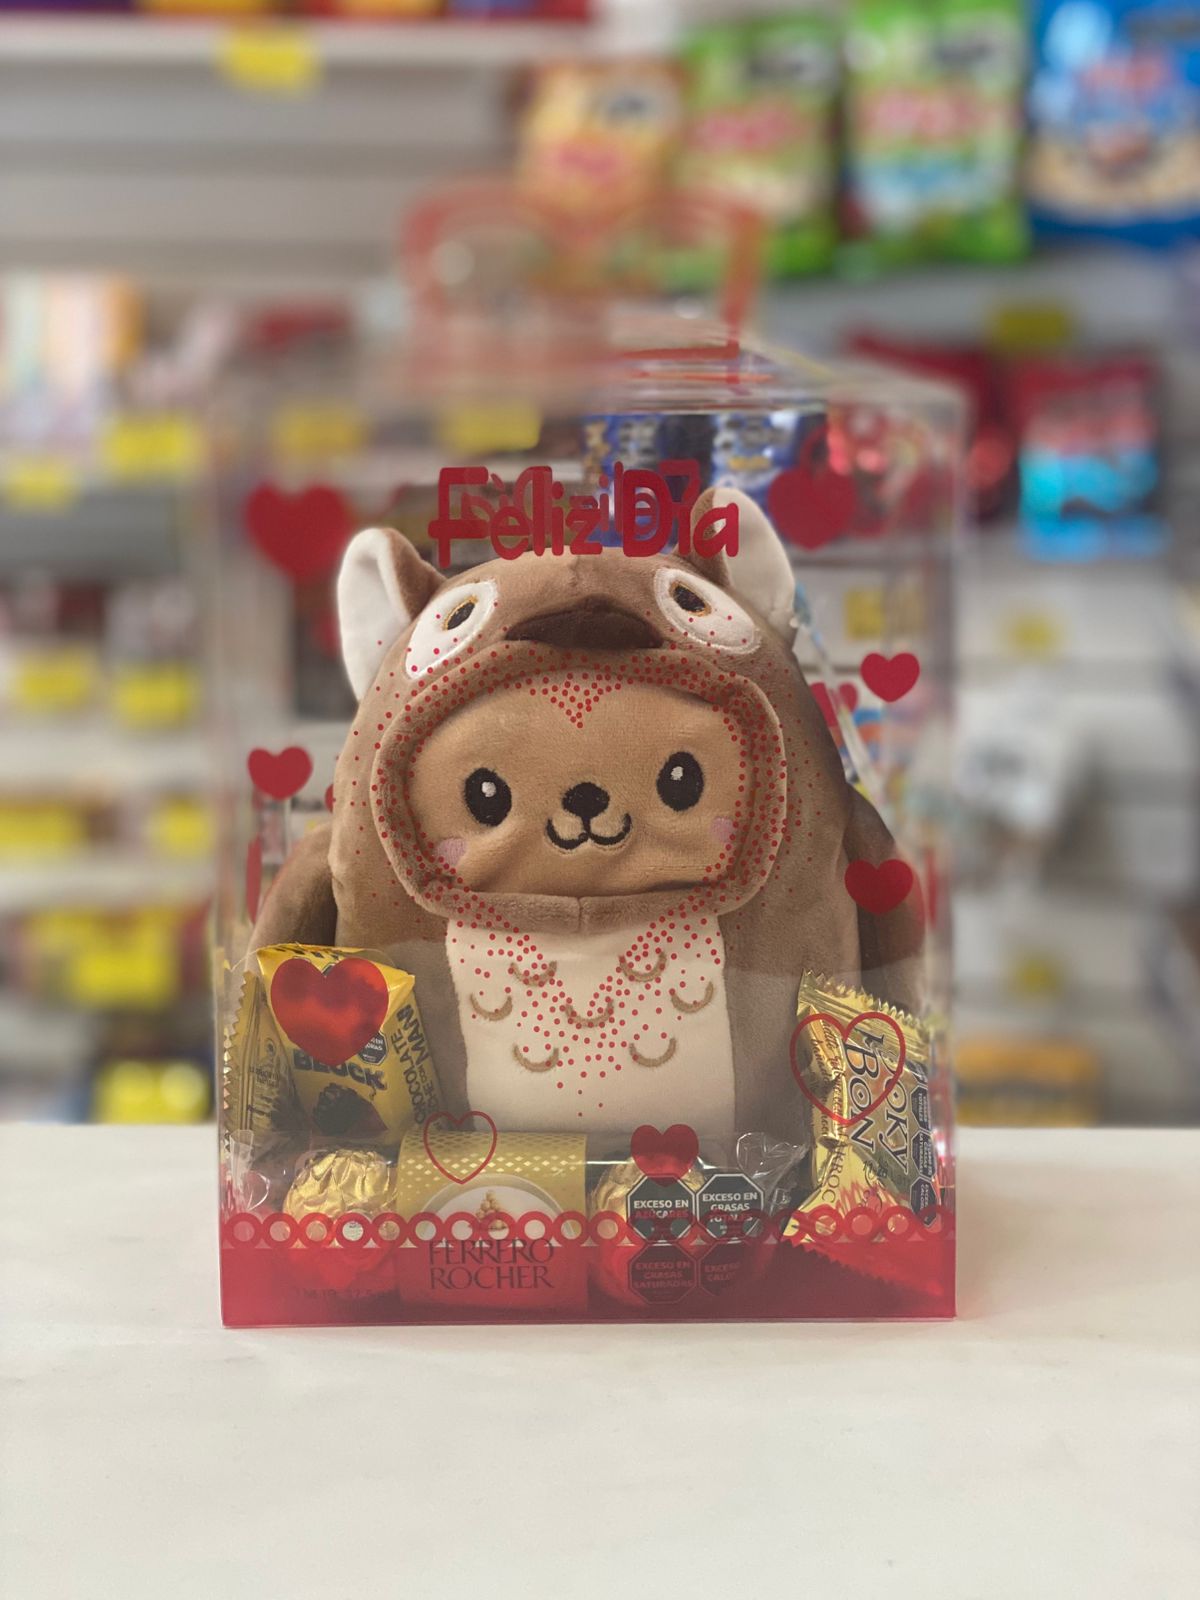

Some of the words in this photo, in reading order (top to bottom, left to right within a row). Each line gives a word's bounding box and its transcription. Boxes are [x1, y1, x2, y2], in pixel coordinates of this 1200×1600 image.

[428, 466, 603, 568] Feliz
[391, 1028, 425, 1124] CHOCOLATE
[844, 1042, 880, 1152] BON
[633, 1200, 673, 1209] EXCESO
[675, 1199, 689, 1208] EN
[702, 1193, 741, 1202] EXCESO
[743, 1192, 758, 1200] EN
[429, 1239, 554, 1264] FERRERO
[430, 1265, 555, 1289] ROCHER
[635, 1261, 673, 1270] EXCESO
